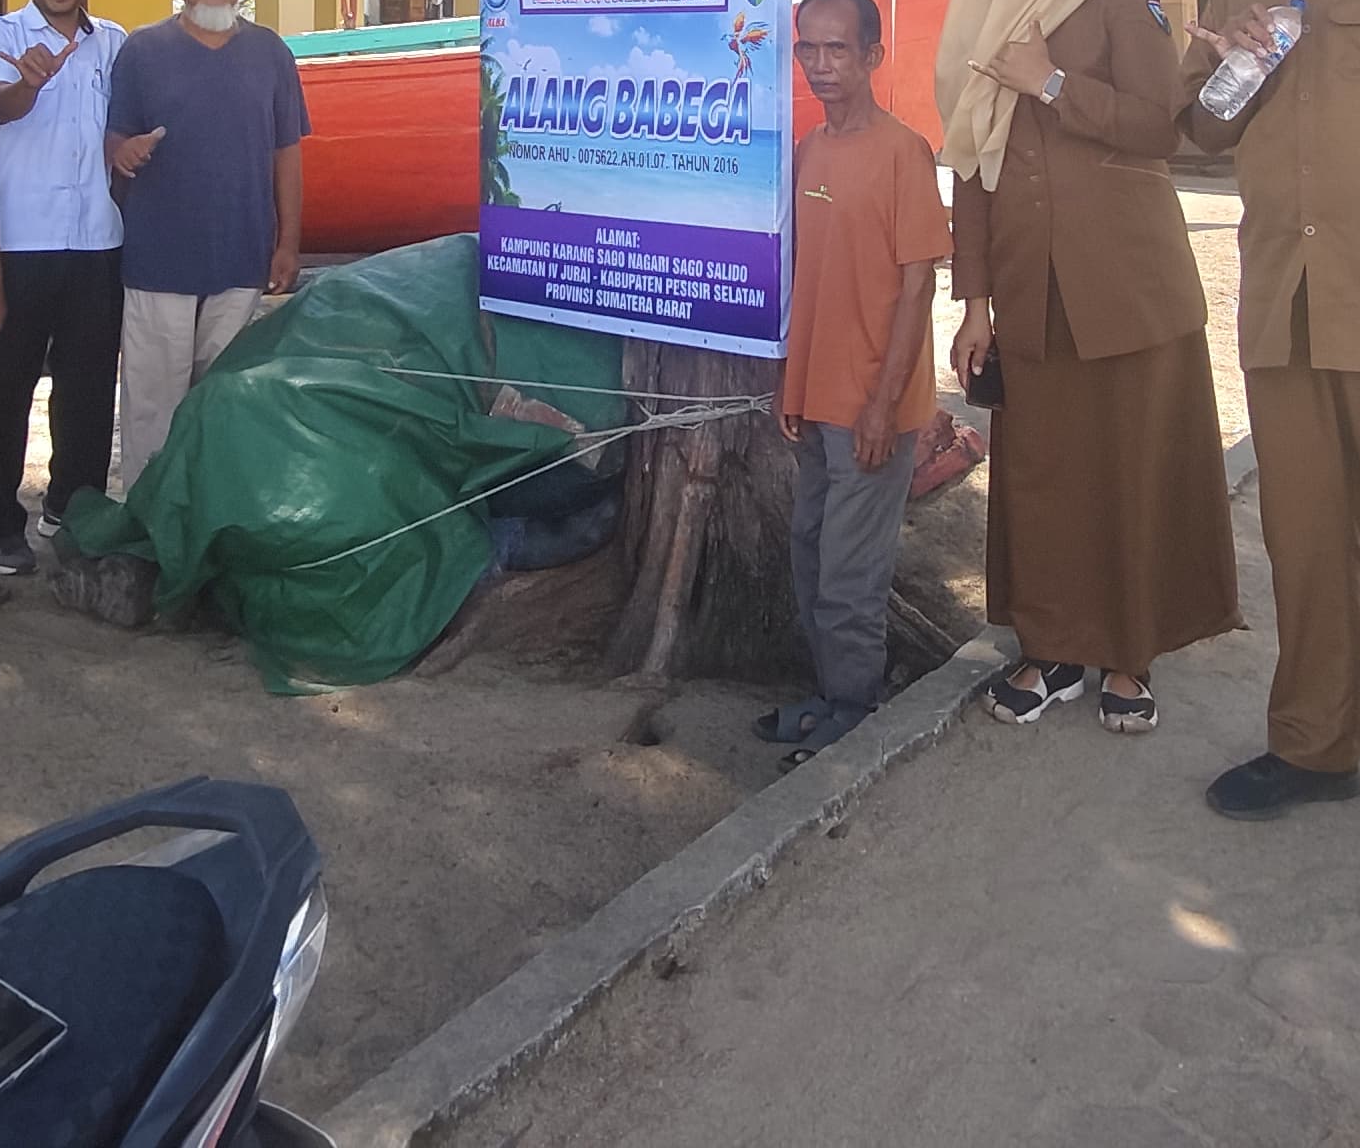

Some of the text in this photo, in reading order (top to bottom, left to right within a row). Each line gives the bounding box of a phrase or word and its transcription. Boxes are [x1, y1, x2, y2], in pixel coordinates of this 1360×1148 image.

[500, 75, 750, 142] ALANG BABEGA
[509, 143, 546, 160] NOMOR
[548, 146, 570, 162] AHU
[672, 153, 710, 172] TAHUN
[713, 156, 739, 174] 2016
[595, 227, 641, 248] ALAMAT:
[487, 253, 546, 278] KECAMATAN
[548, 262, 558, 279] IV
[561, 264, 591, 284] JURAI
[600, 269, 663, 294] KABUPATEN
[665, 278, 711, 301] PESISIR
[713, 284, 765, 308] SELATAN
[501, 236, 551, 258] KAMPUNG
[553, 242, 595, 264] KARANG
[628, 253, 669, 274] NAGARI
[672, 257, 703, 277] SAGO
[706, 261, 748, 283] SALIDO
[545, 282, 693, 320] PROVINSI SUMATERA BARAT
